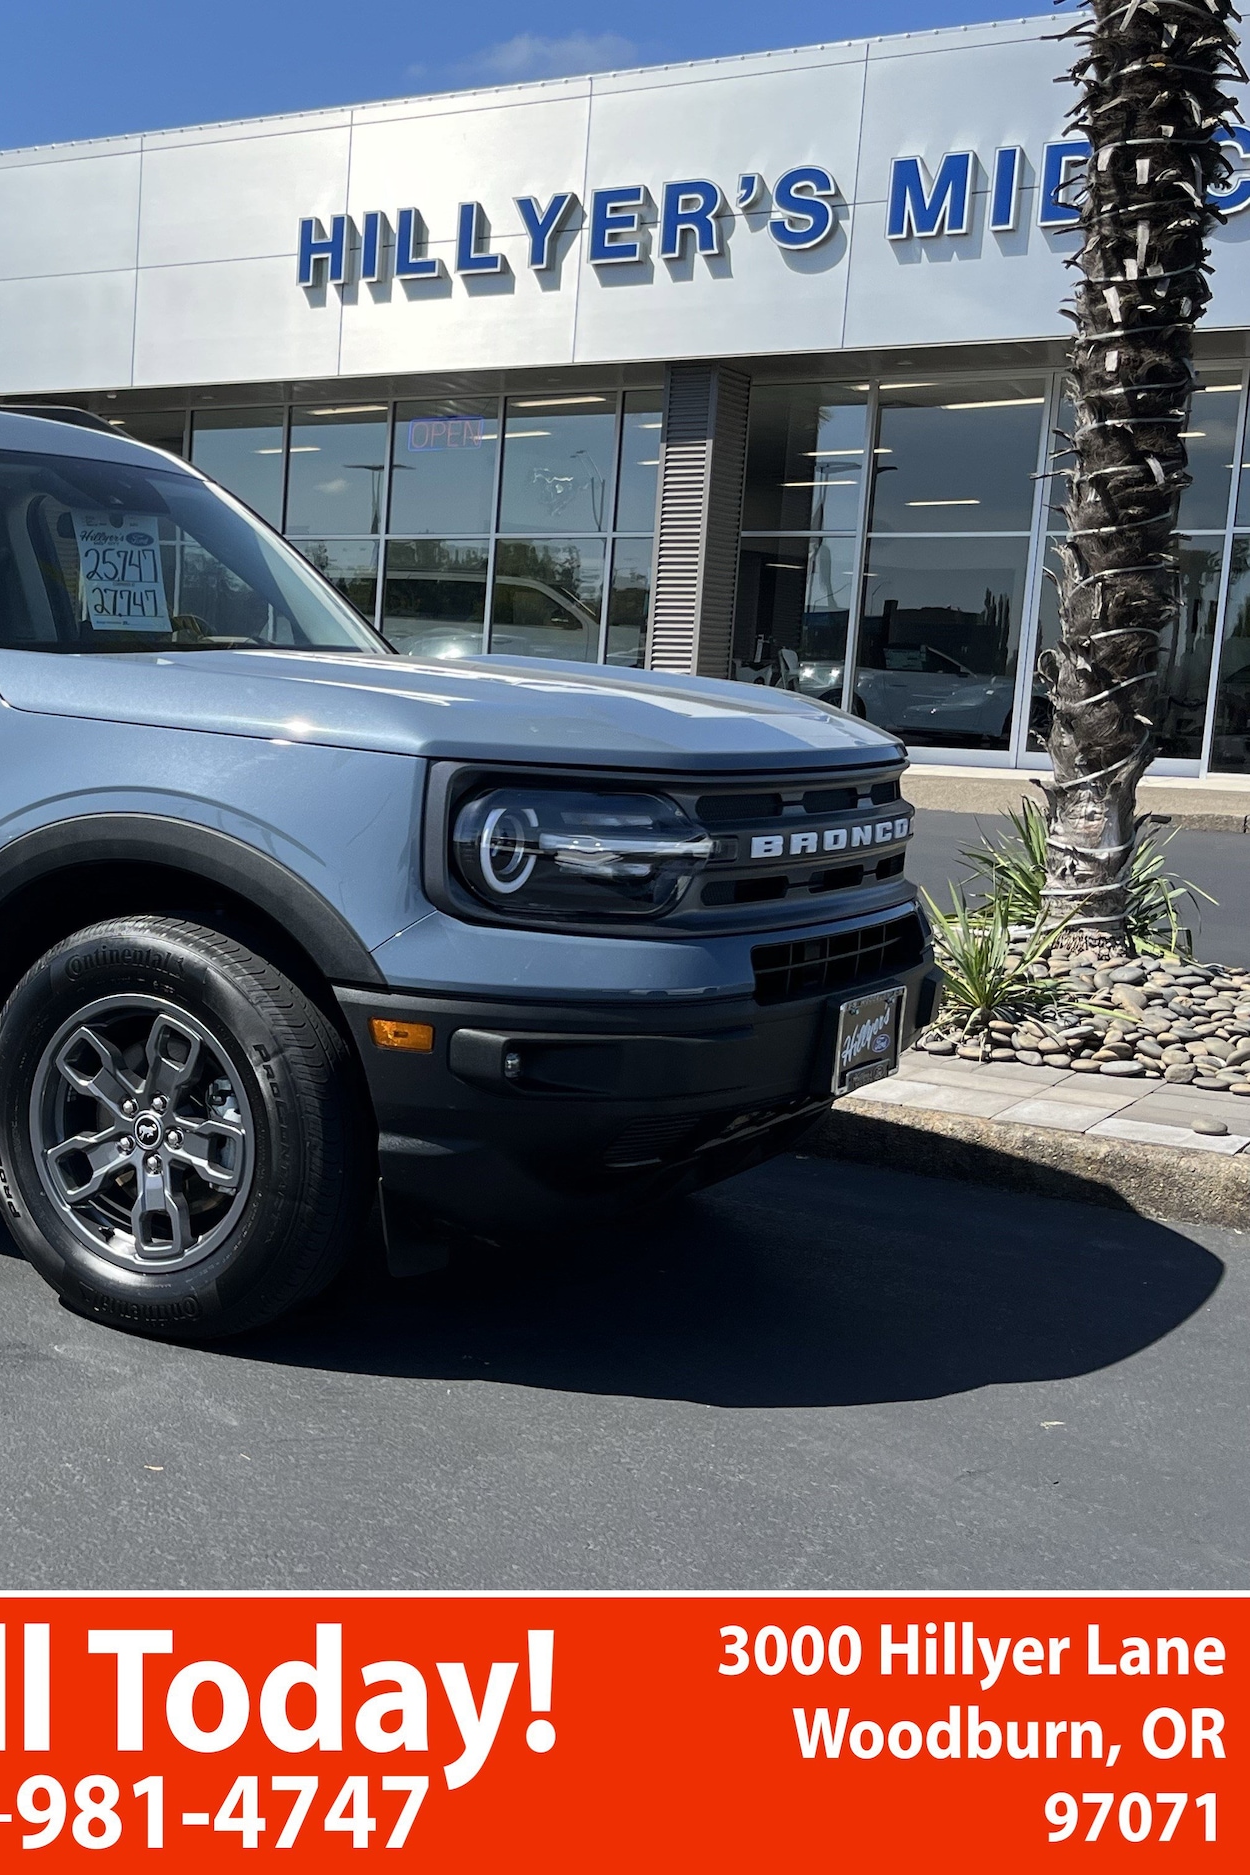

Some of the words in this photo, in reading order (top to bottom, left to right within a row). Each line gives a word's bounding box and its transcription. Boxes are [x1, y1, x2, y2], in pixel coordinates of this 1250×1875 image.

[297, 164, 838, 288] HILLYER'S
[411, 420, 482, 449] OPEN
[751, 817, 909, 859] BRONCO
[64, 944, 173, 982] Continental
